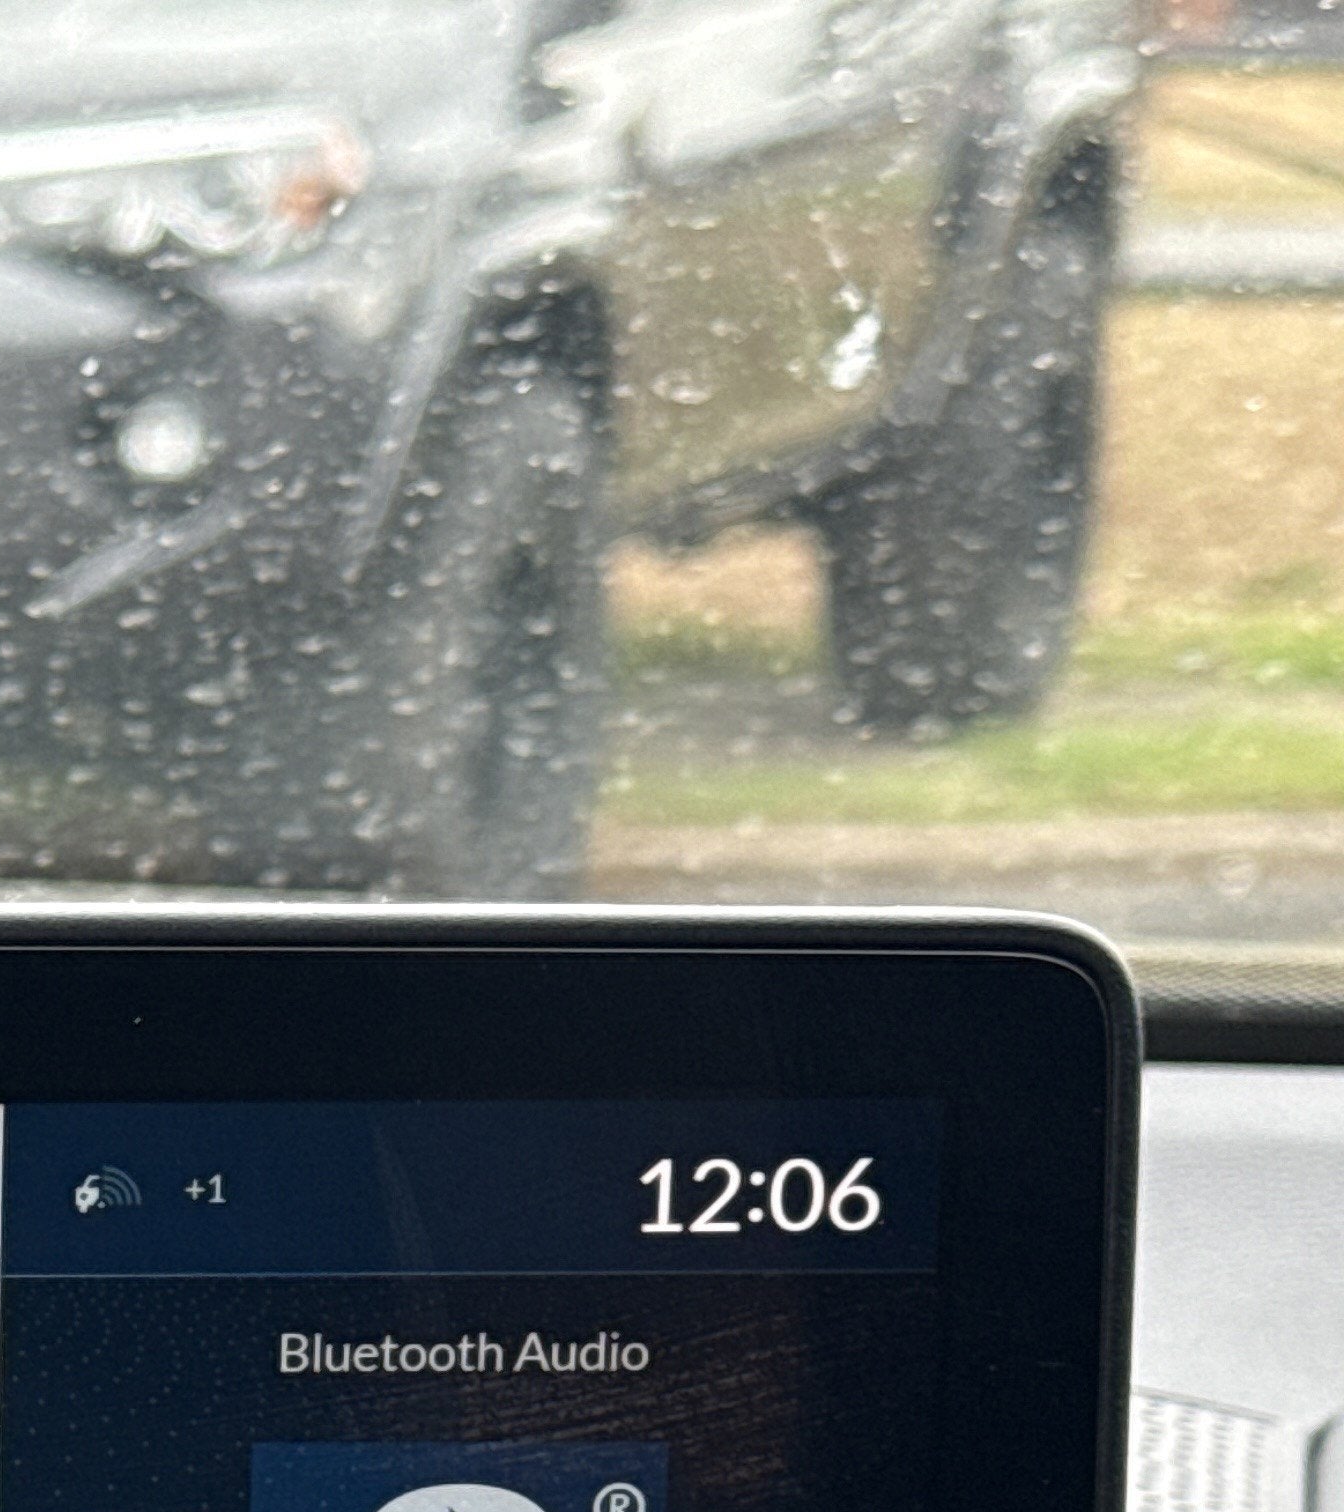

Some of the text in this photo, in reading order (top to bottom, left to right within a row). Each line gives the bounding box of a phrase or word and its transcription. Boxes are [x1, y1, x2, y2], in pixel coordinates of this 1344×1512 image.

[183, 1171, 227, 1204] +1
[638, 1158, 882, 1233] 12:06
[277, 1332, 651, 1374] Bluetooth Audio
